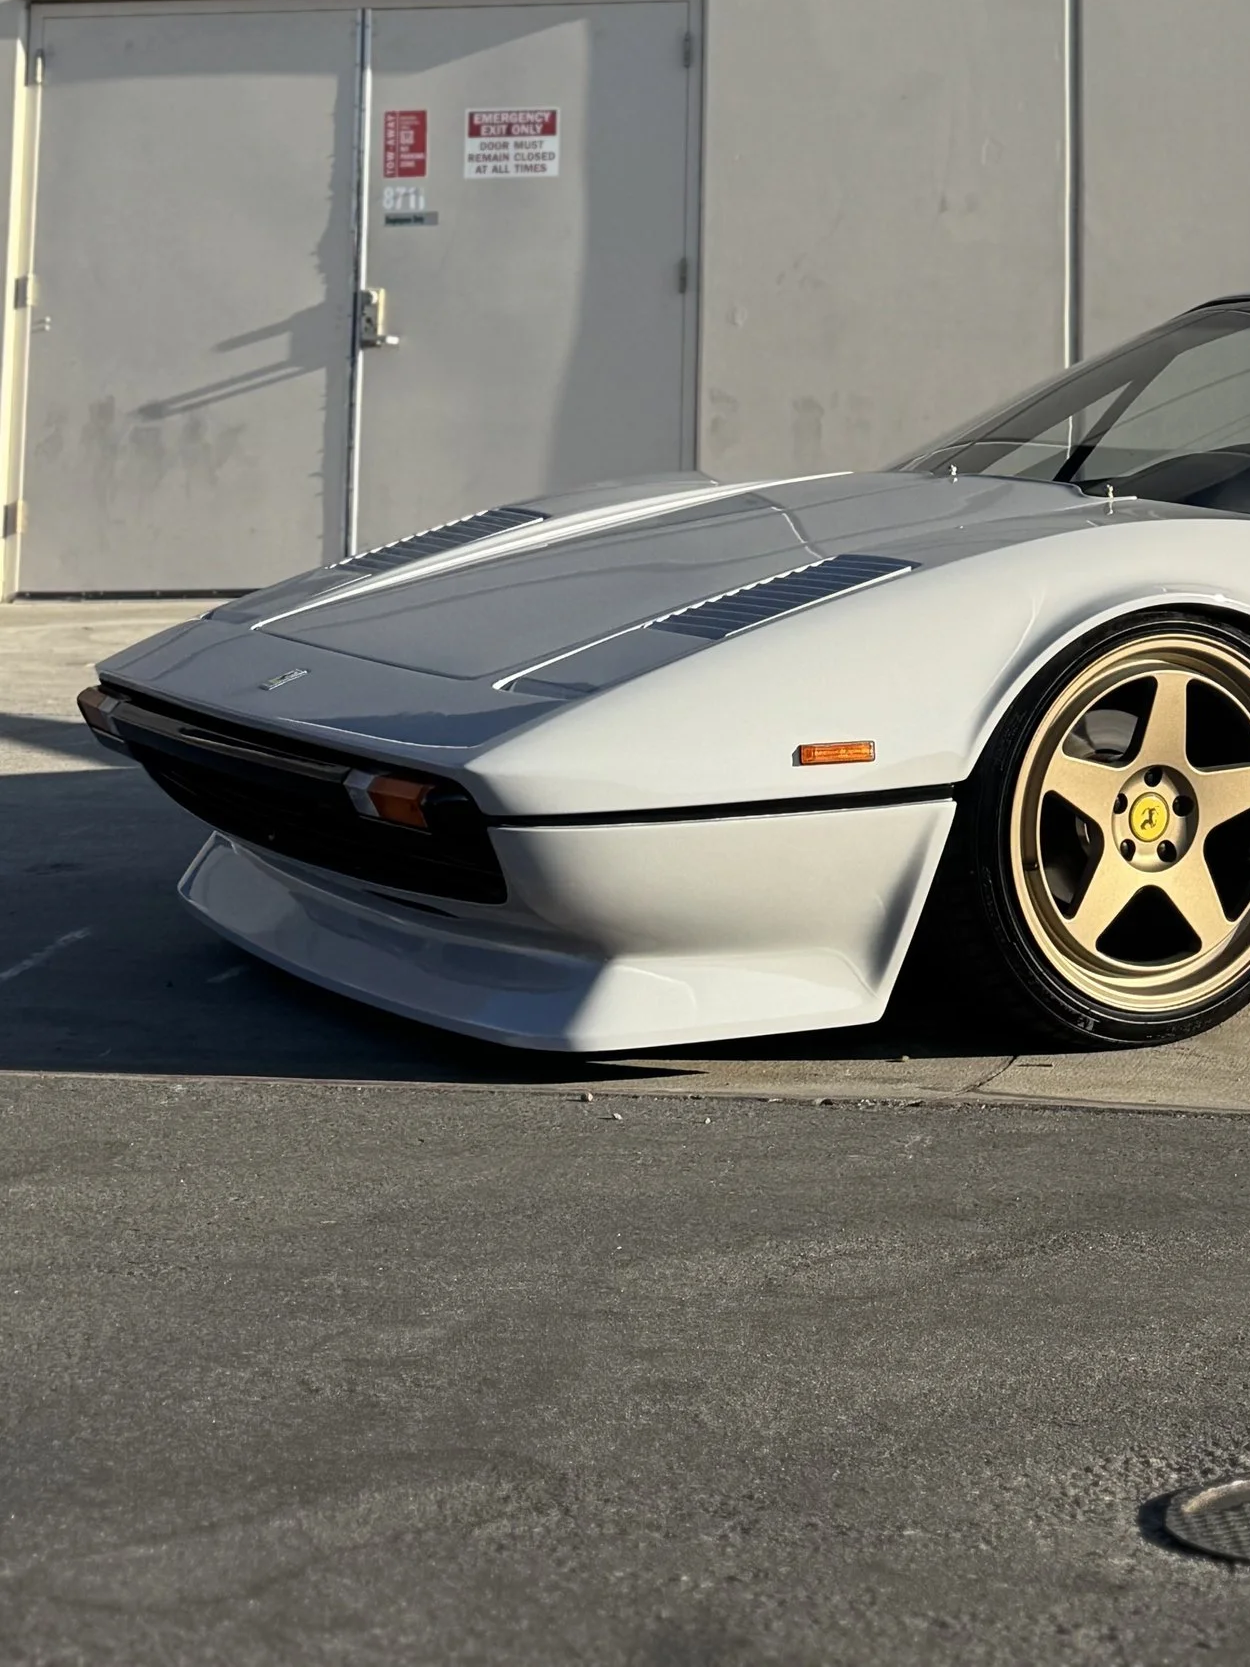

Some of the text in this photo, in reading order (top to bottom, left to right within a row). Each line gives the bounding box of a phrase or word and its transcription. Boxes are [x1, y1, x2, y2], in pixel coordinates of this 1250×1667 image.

[473, 112, 551, 124] EMERGENCY
[480, 123, 544, 136] EXIT ONLY
[386, 114, 395, 174] TOW-AWAY
[480, 140, 544, 151] DOOR MUST
[468, 151, 556, 163] REMAIN CLOSED
[475, 163, 547, 174] AT ALL TIMES
